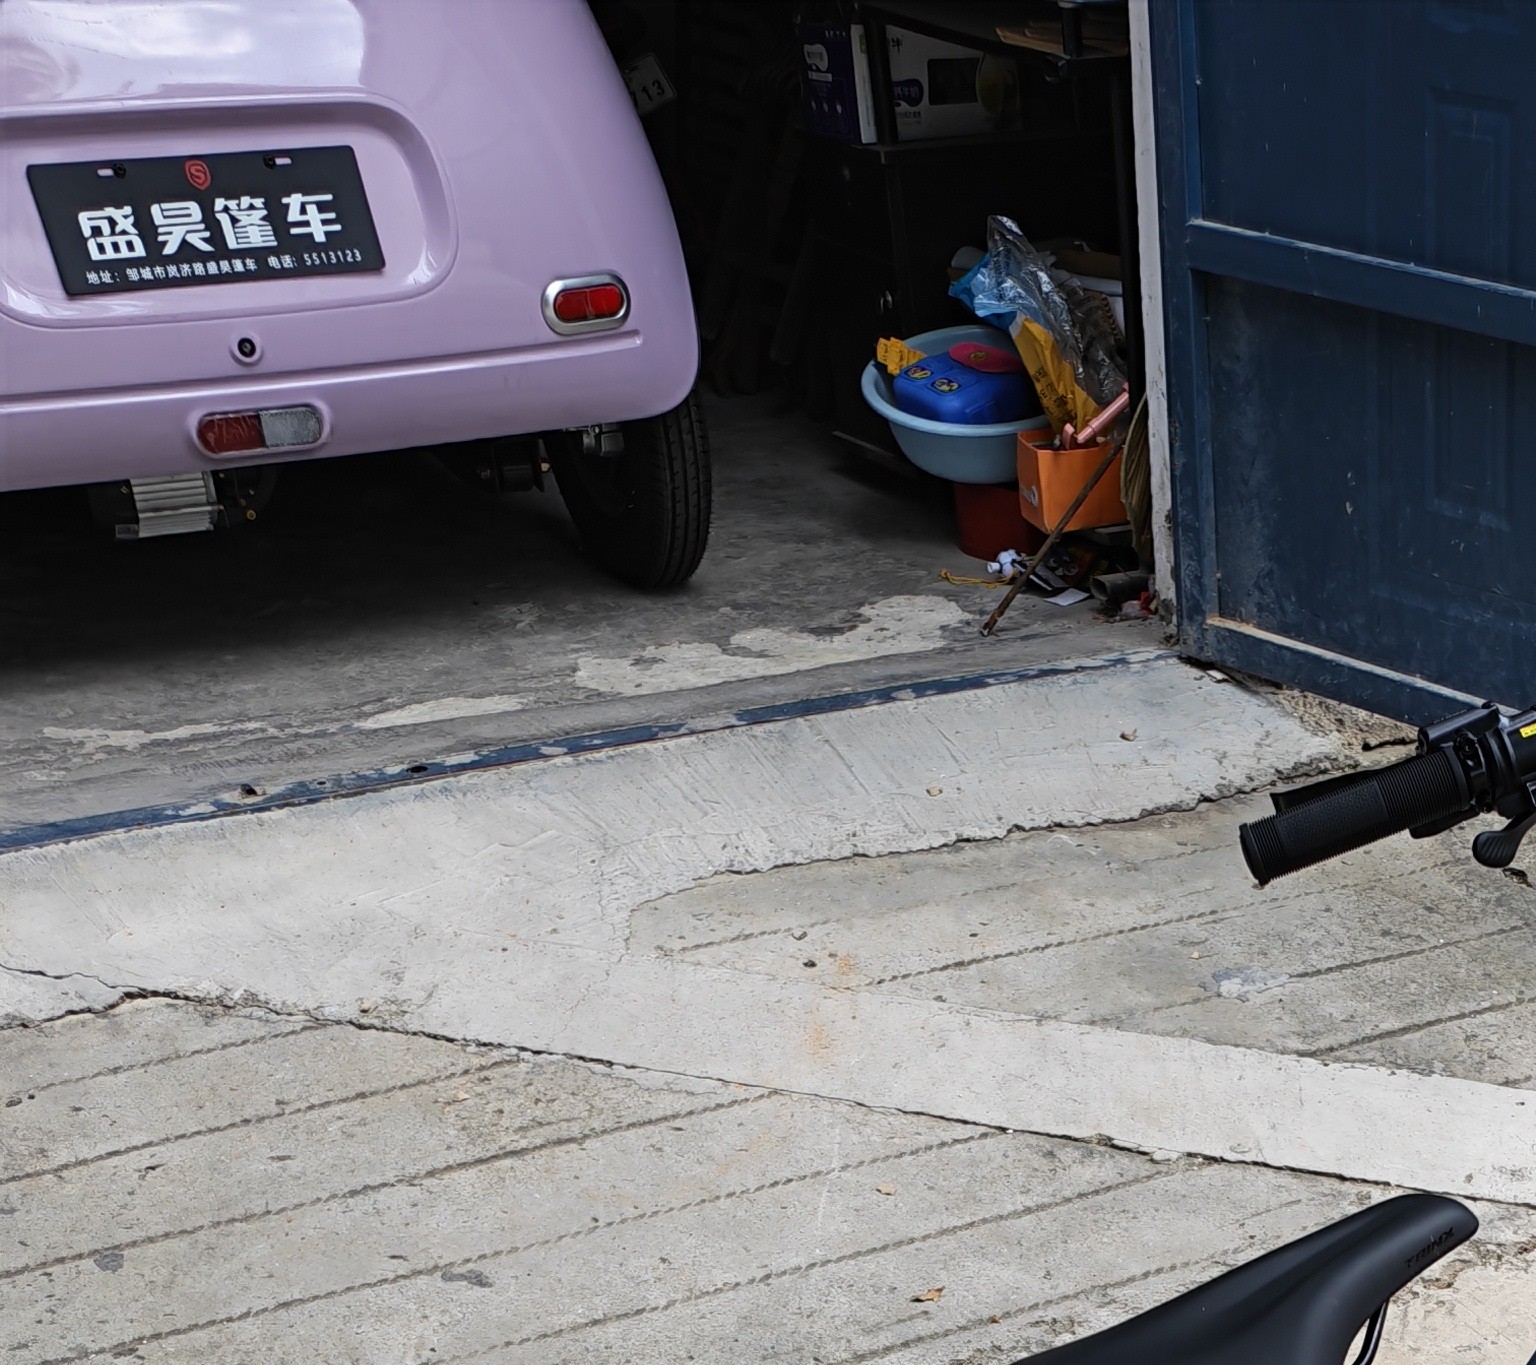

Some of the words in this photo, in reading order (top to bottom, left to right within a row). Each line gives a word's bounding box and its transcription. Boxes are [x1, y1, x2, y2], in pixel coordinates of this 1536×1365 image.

[78, 193, 342, 261] 盛昊篷车
[1404, 1226, 1455, 1269] TRINX
